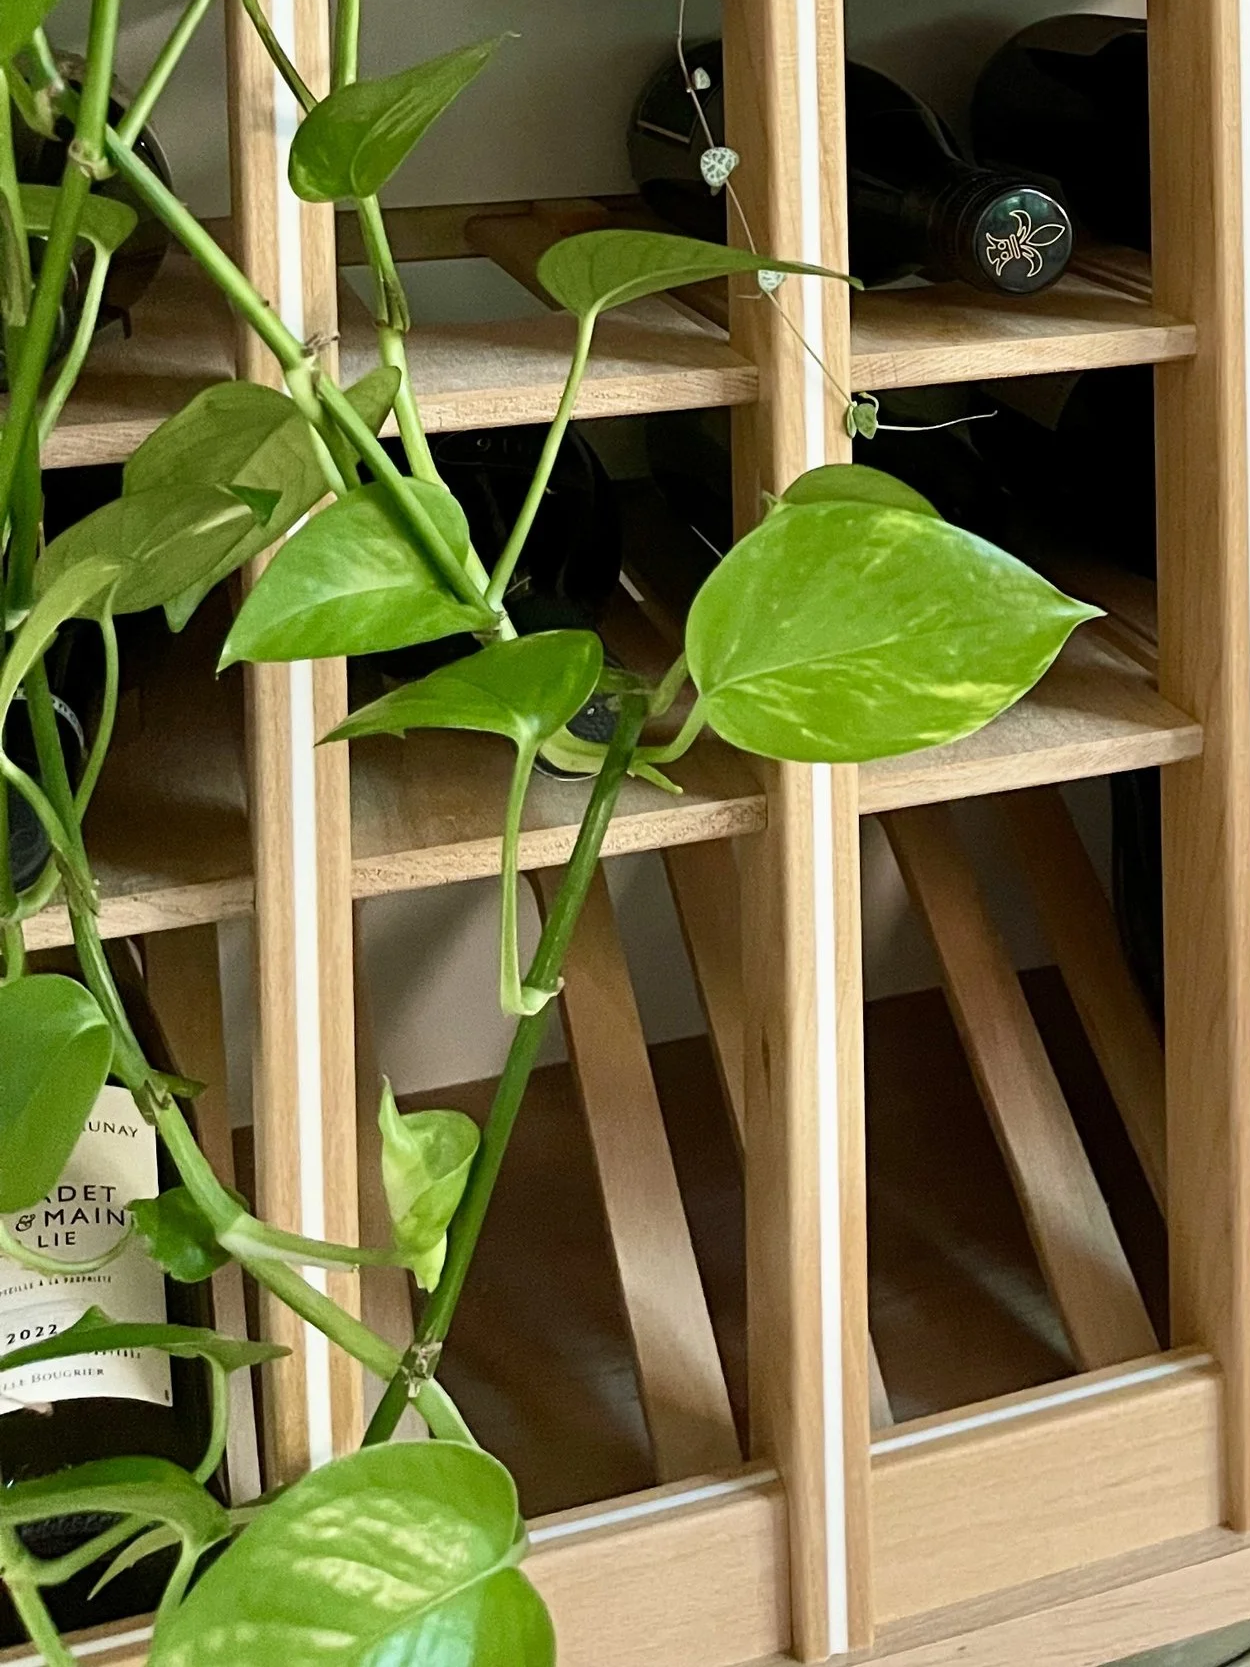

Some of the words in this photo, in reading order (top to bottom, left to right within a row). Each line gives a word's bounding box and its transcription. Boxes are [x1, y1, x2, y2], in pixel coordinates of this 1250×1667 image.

[83, 1121, 138, 1137] UNAY
[15, 1213, 37, 1233] &
[44, 1207, 126, 1227] MAIN
[37, 1231, 77, 1249] LIE
[6, 1324, 58, 1345] 2022
[31, 1368, 105, 1384] BOUGRIER
